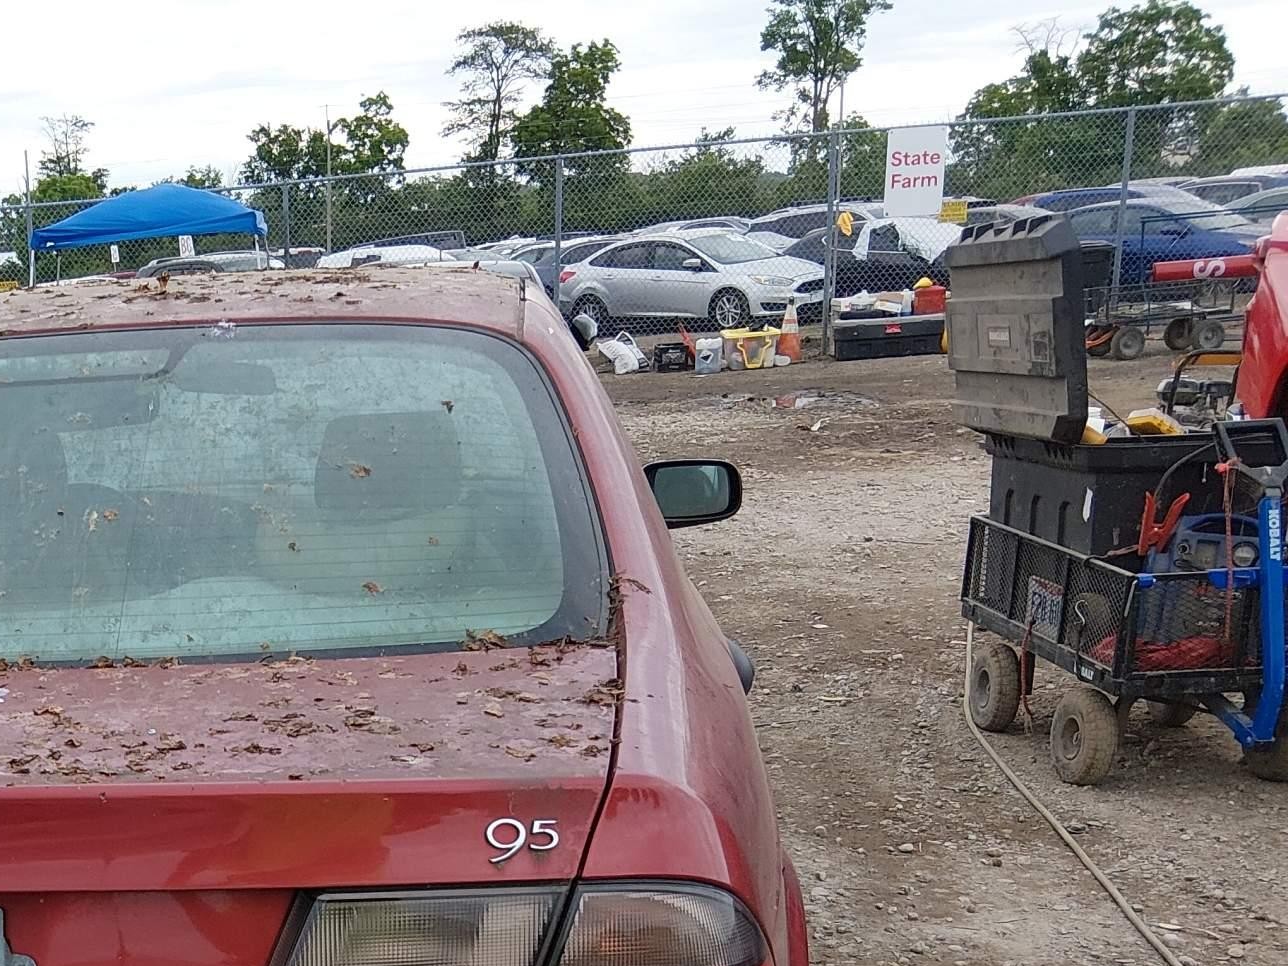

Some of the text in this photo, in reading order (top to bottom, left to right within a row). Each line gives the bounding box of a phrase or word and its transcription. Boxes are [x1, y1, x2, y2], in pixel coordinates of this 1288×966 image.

[891, 150, 941, 167] State
[891, 174, 938, 189] Farm
[1268, 509, 1281, 561] KOBALT
[486, 817, 560, 863] 95
